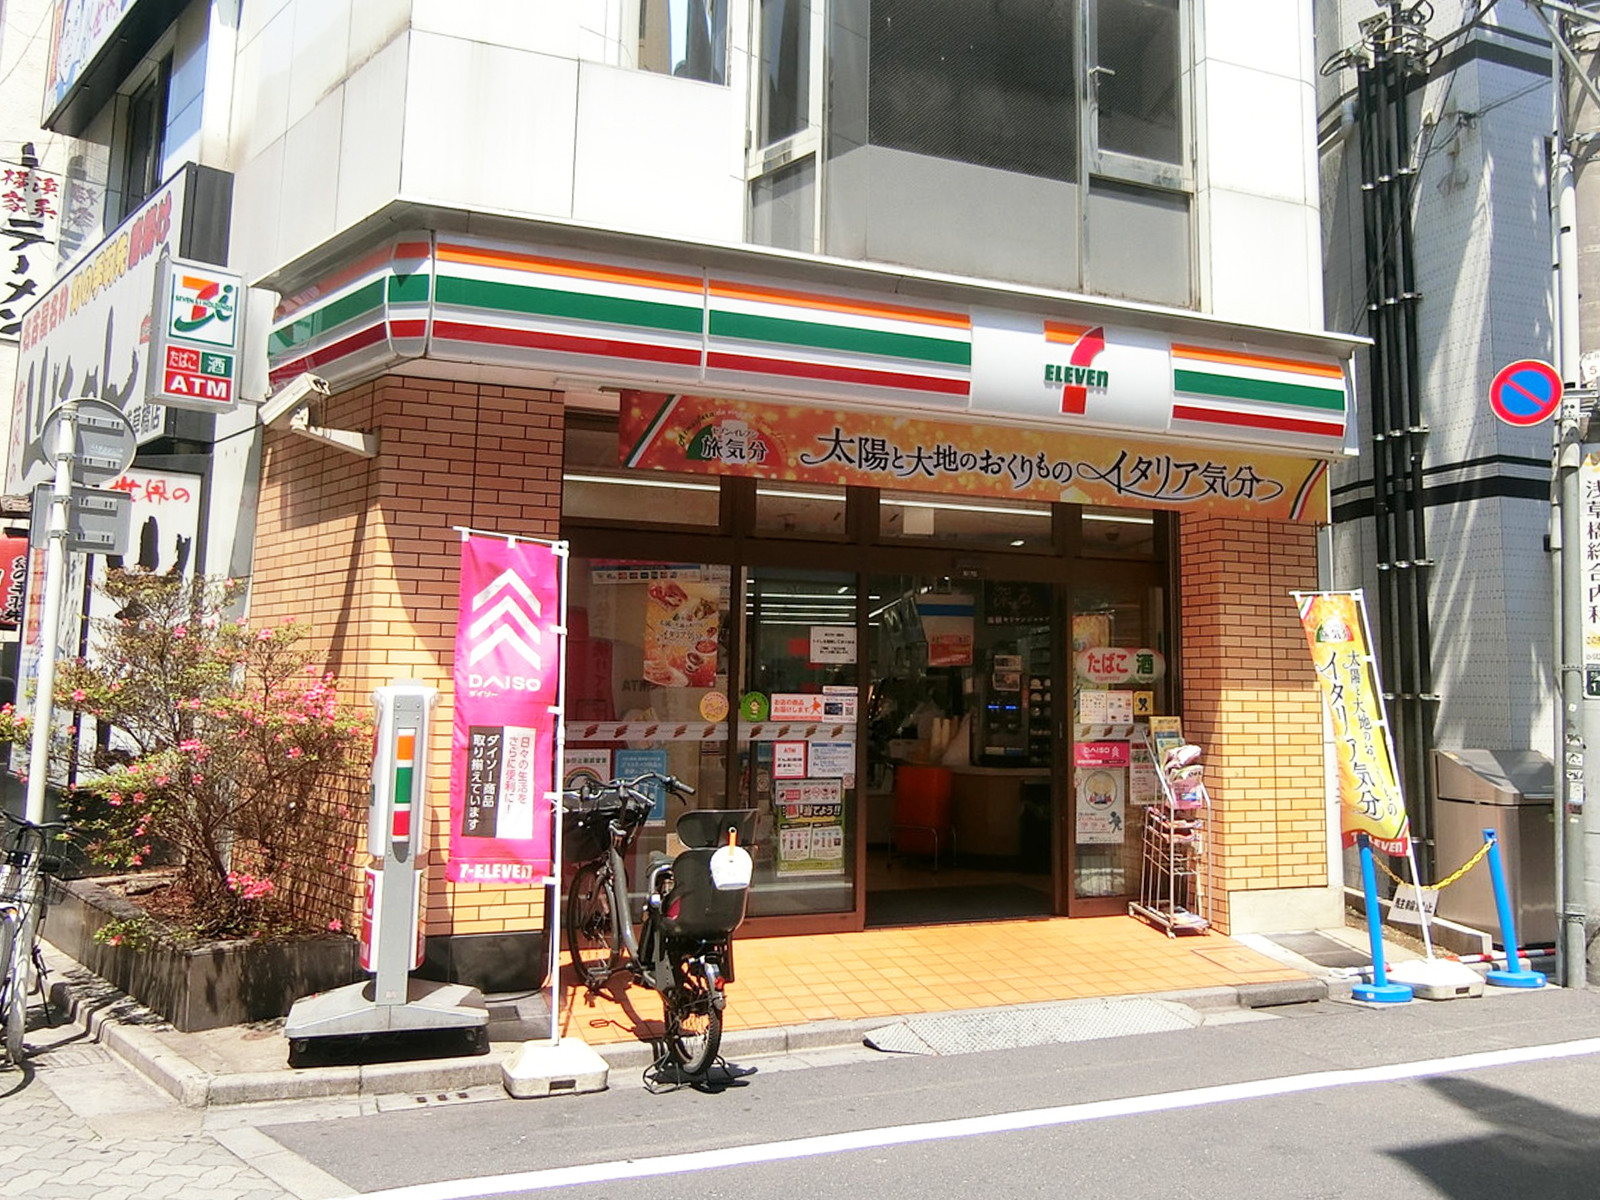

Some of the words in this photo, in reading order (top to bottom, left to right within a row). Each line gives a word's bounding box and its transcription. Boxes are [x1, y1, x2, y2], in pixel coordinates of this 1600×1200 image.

[168, 350, 197, 370] たばこ
[208, 355, 227, 374] 酒
[170, 375, 227, 398] ATM
[701, 437, 767, 461] 旅気分
[800, 427, 1073, 490] 太陽と大地のおくりもの
[1077, 449, 1284, 503] イタリア気分
[1087, 652, 1129, 674] たばこ
[1136, 653, 1154, 675] 酒
[469, 674, 541, 692] DAISO
[468, 734, 486, 831] 取り揃えています
[482, 734, 500, 808] ダイソー商品
[517, 736, 531, 805] 日々の生活を
